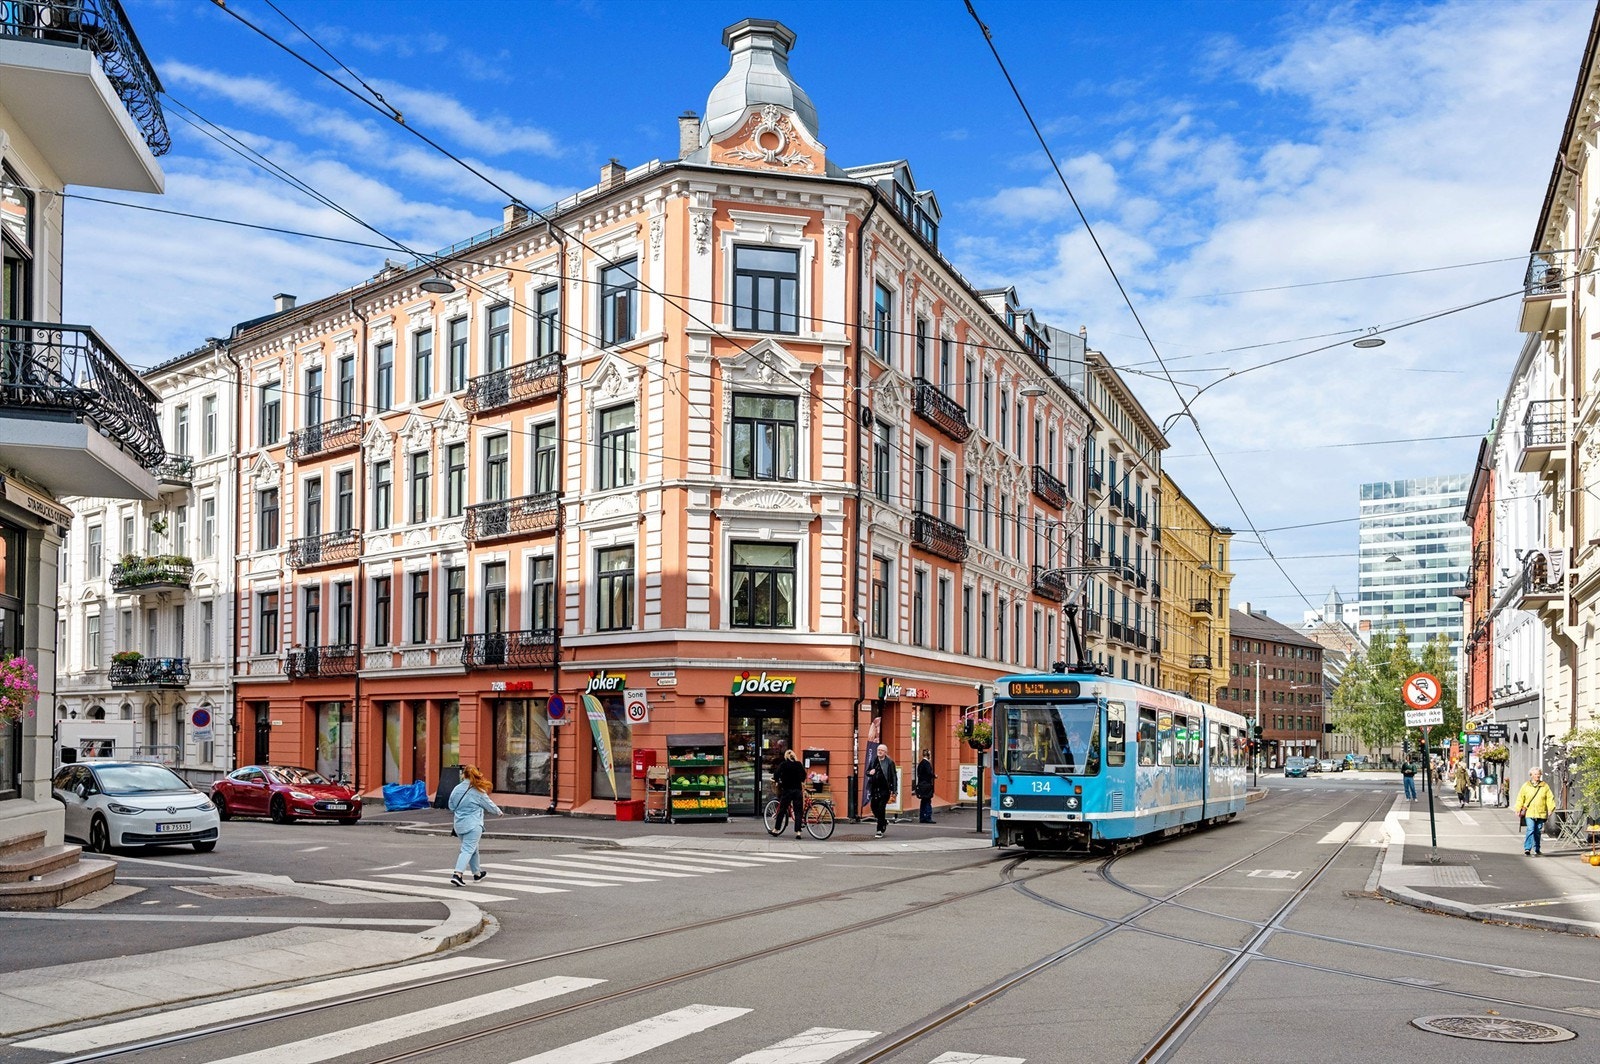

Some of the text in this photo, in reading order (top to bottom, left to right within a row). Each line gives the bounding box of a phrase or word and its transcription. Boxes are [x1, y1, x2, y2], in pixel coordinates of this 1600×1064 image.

[27, 497, 70, 527] STARBUCKS COFFEE
[585, 670, 620, 694] joker
[734, 670, 792, 696] joker
[884, 677, 902, 700] joker
[631, 706, 642, 716] 30
[1032, 781, 1051, 792] 134
